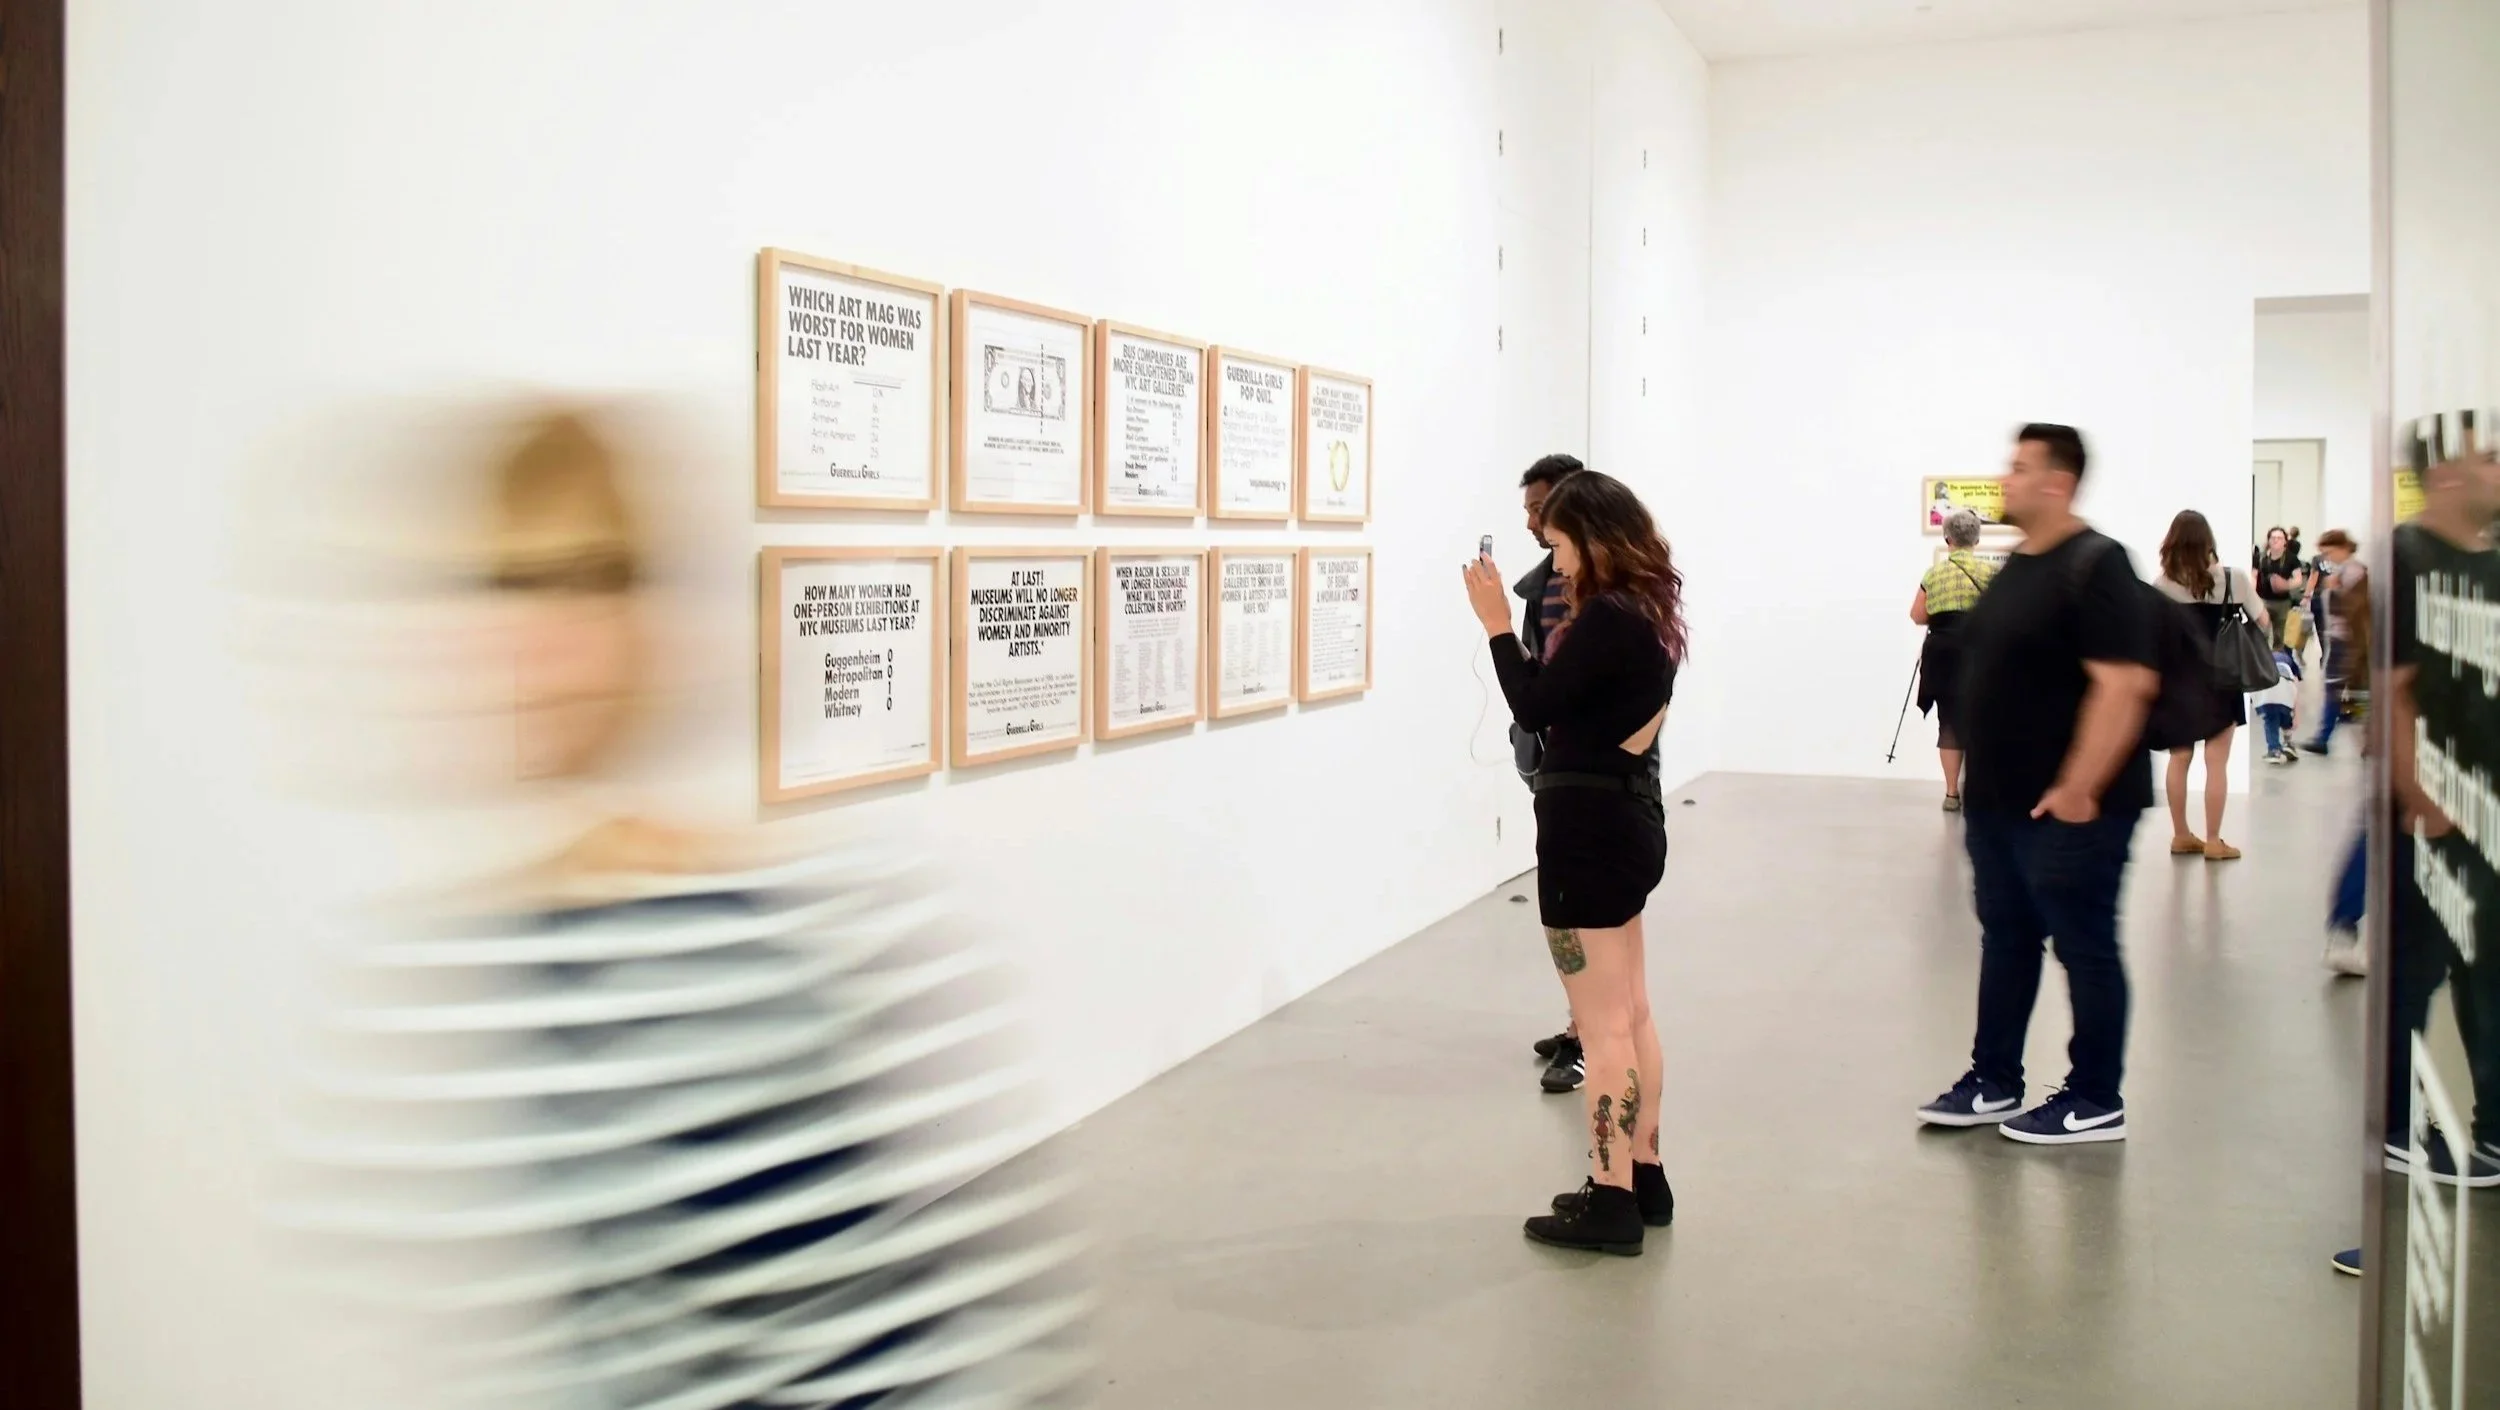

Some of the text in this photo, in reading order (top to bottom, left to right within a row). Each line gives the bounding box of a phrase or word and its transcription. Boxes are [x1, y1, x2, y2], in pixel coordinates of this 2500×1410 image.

[788, 285, 922, 330] WHICH ART MAG WAS
[788, 310, 914, 351] WORST FOR WOMEN
[787, 335, 866, 367] LAST YEAR?
[1123, 343, 1187, 369] BUS COMPANIES ARE
[1113, 357, 1194, 385] MORE ENLIGHTENED THAN
[1226, 365, 1263, 387] GUERRILLA
[1124, 375, 1137, 390] NYC
[1139, 378, 1151, 392] ART
[1240, 384, 1255, 401] POP
[1011, 569, 1044, 587] AT LAST!
[1115, 566, 1133, 578] WHEN
[1134, 566, 1154, 578] RACISM
[1155, 566, 1160, 577] &
[1161, 566, 1180, 577] SEXISM
[804, 583, 912, 601] HOW MANY WOMEN HAD
[1120, 579, 1130, 590] NO
[1131, 578, 1151, 590] LONGER
[1223, 576, 1249, 589] GALLERIES
[970, 587, 1078, 606] MUSEUMS WILL NO LONGER
[1126, 589, 1183, 602] WHAT WILL YOUR ART
[1221, 590, 1242, 602] WOMEN
[793, 599, 920, 619] ONE-PERSON EXHIBITIONS AT
[979, 604, 1070, 623] DISCRIMINATE AGAINST
[1124, 600, 1186, 615] COLLECTION BE WORTH?
[799, 615, 916, 637] NYC MUSEUMS LAST YEAR?
[978, 621, 1071, 642] WOMEN AND MINORITY
[825, 649, 881, 671] Guggenheim
[824, 665, 883, 685] Metropolitan
[824, 684, 860, 702] Modern
[824, 701, 862, 719] Whitney
